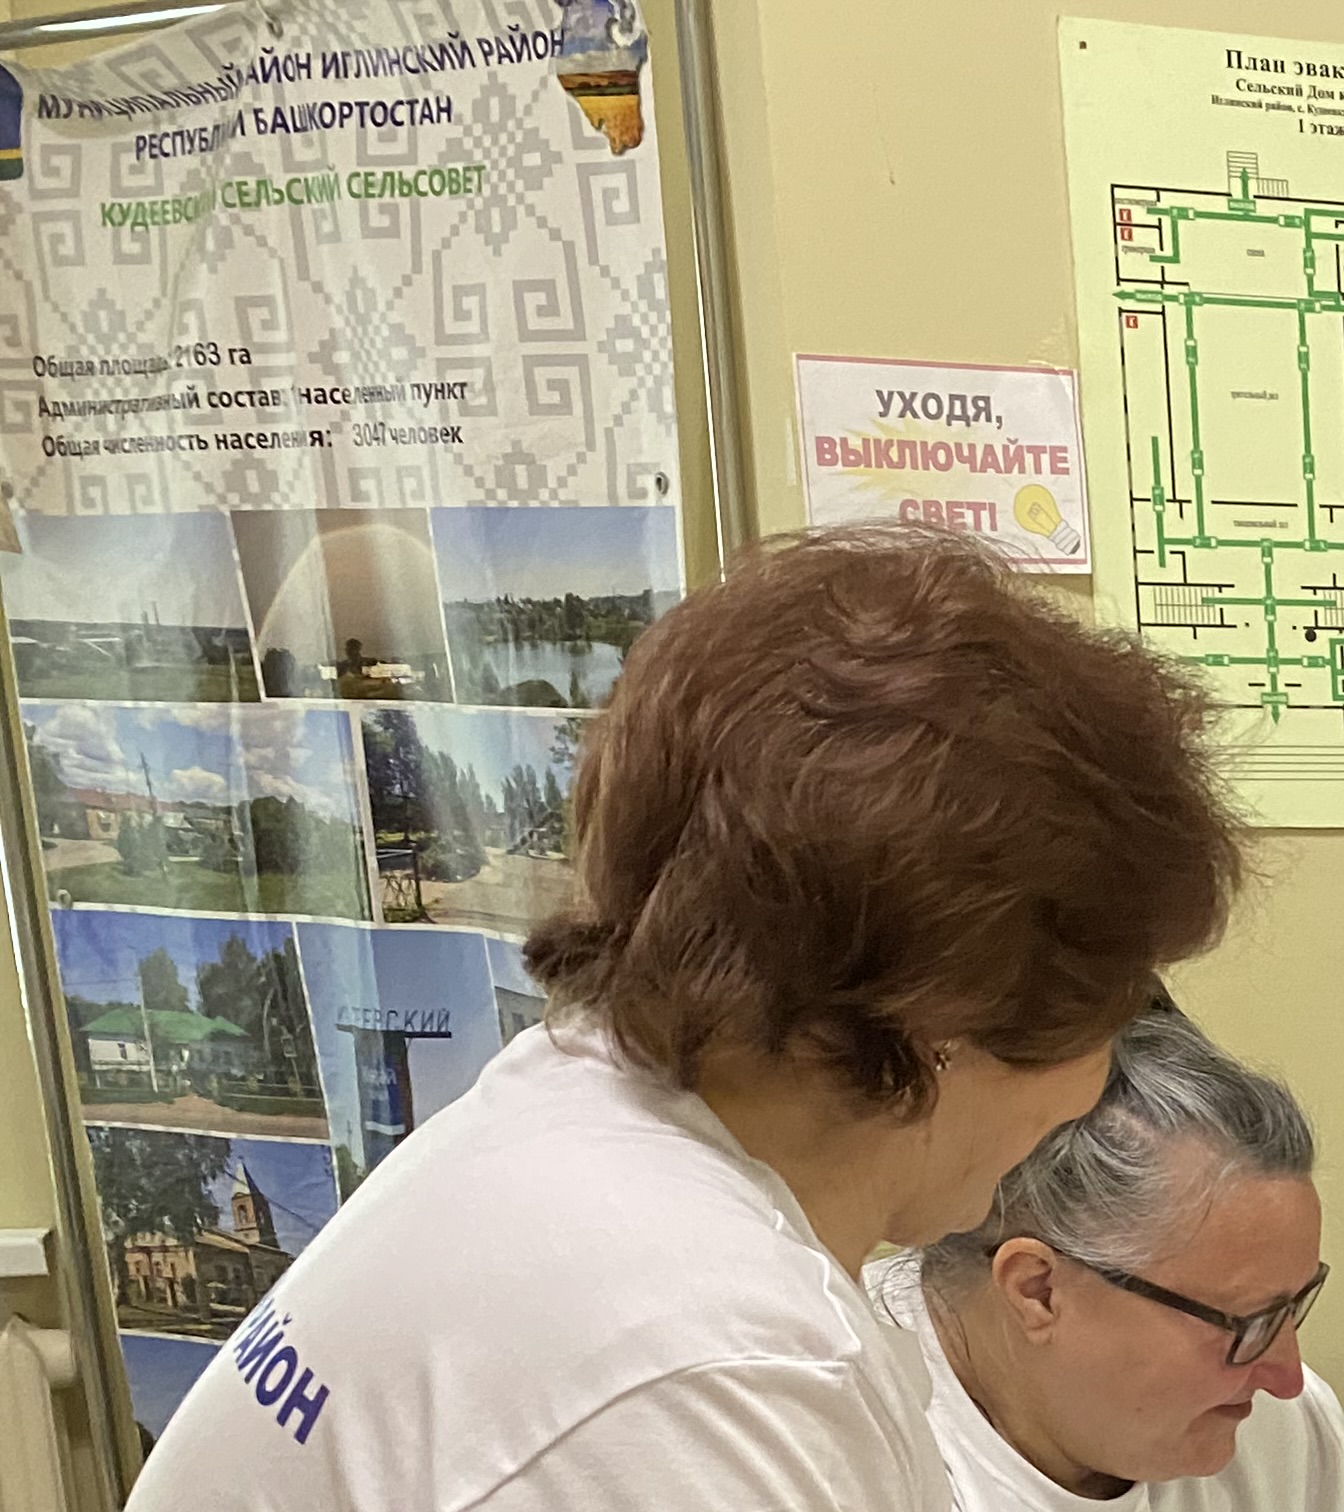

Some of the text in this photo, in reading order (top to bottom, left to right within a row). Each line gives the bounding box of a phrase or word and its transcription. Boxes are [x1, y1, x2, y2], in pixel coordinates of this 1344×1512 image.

[321, 32, 474, 79] ИГЛИНСКИЙ
[481, 28, 566, 66] РАЙОН
[1226, 49, 1286, 74] План
[1236, 79, 1303, 98] Сельский
[1307, 84, 1334, 101] Дом
[254, 95, 453, 137] БАШКОРТОСТАН
[221, 165, 341, 209] СЕЛЬСКИЙ
[347, 164, 487, 200] СЕЛЬСОВЕТ
[228, 346, 253, 366] га
[411, 381, 469, 408] пункт
[875, 388, 1003, 430] УХОДЯ,
[389, 425, 464, 447] человек
[814, 435, 1071, 476] ВЫКЛЮЧАЙТЕ
